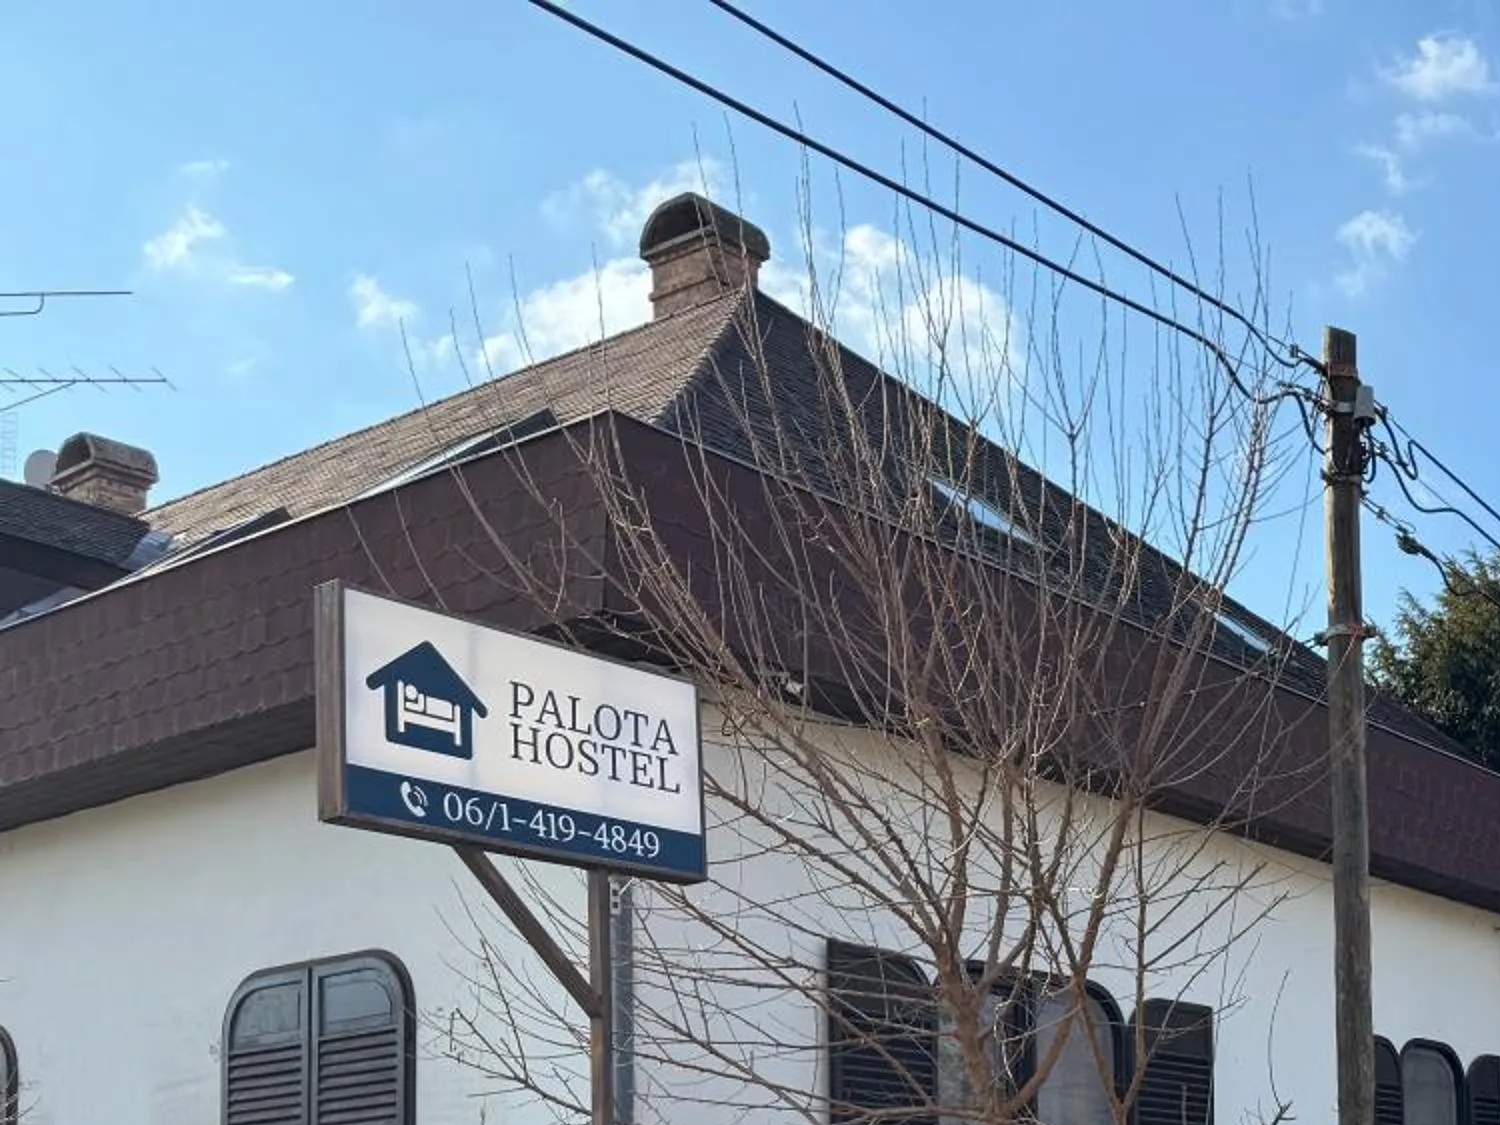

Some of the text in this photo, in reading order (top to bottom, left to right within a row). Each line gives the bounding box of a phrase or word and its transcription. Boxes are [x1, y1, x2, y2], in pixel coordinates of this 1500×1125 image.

[509, 681, 679, 755] PALOTA
[509, 722, 681, 794] HOSTEL
[443, 791, 660, 860] 06/1-419-4849
